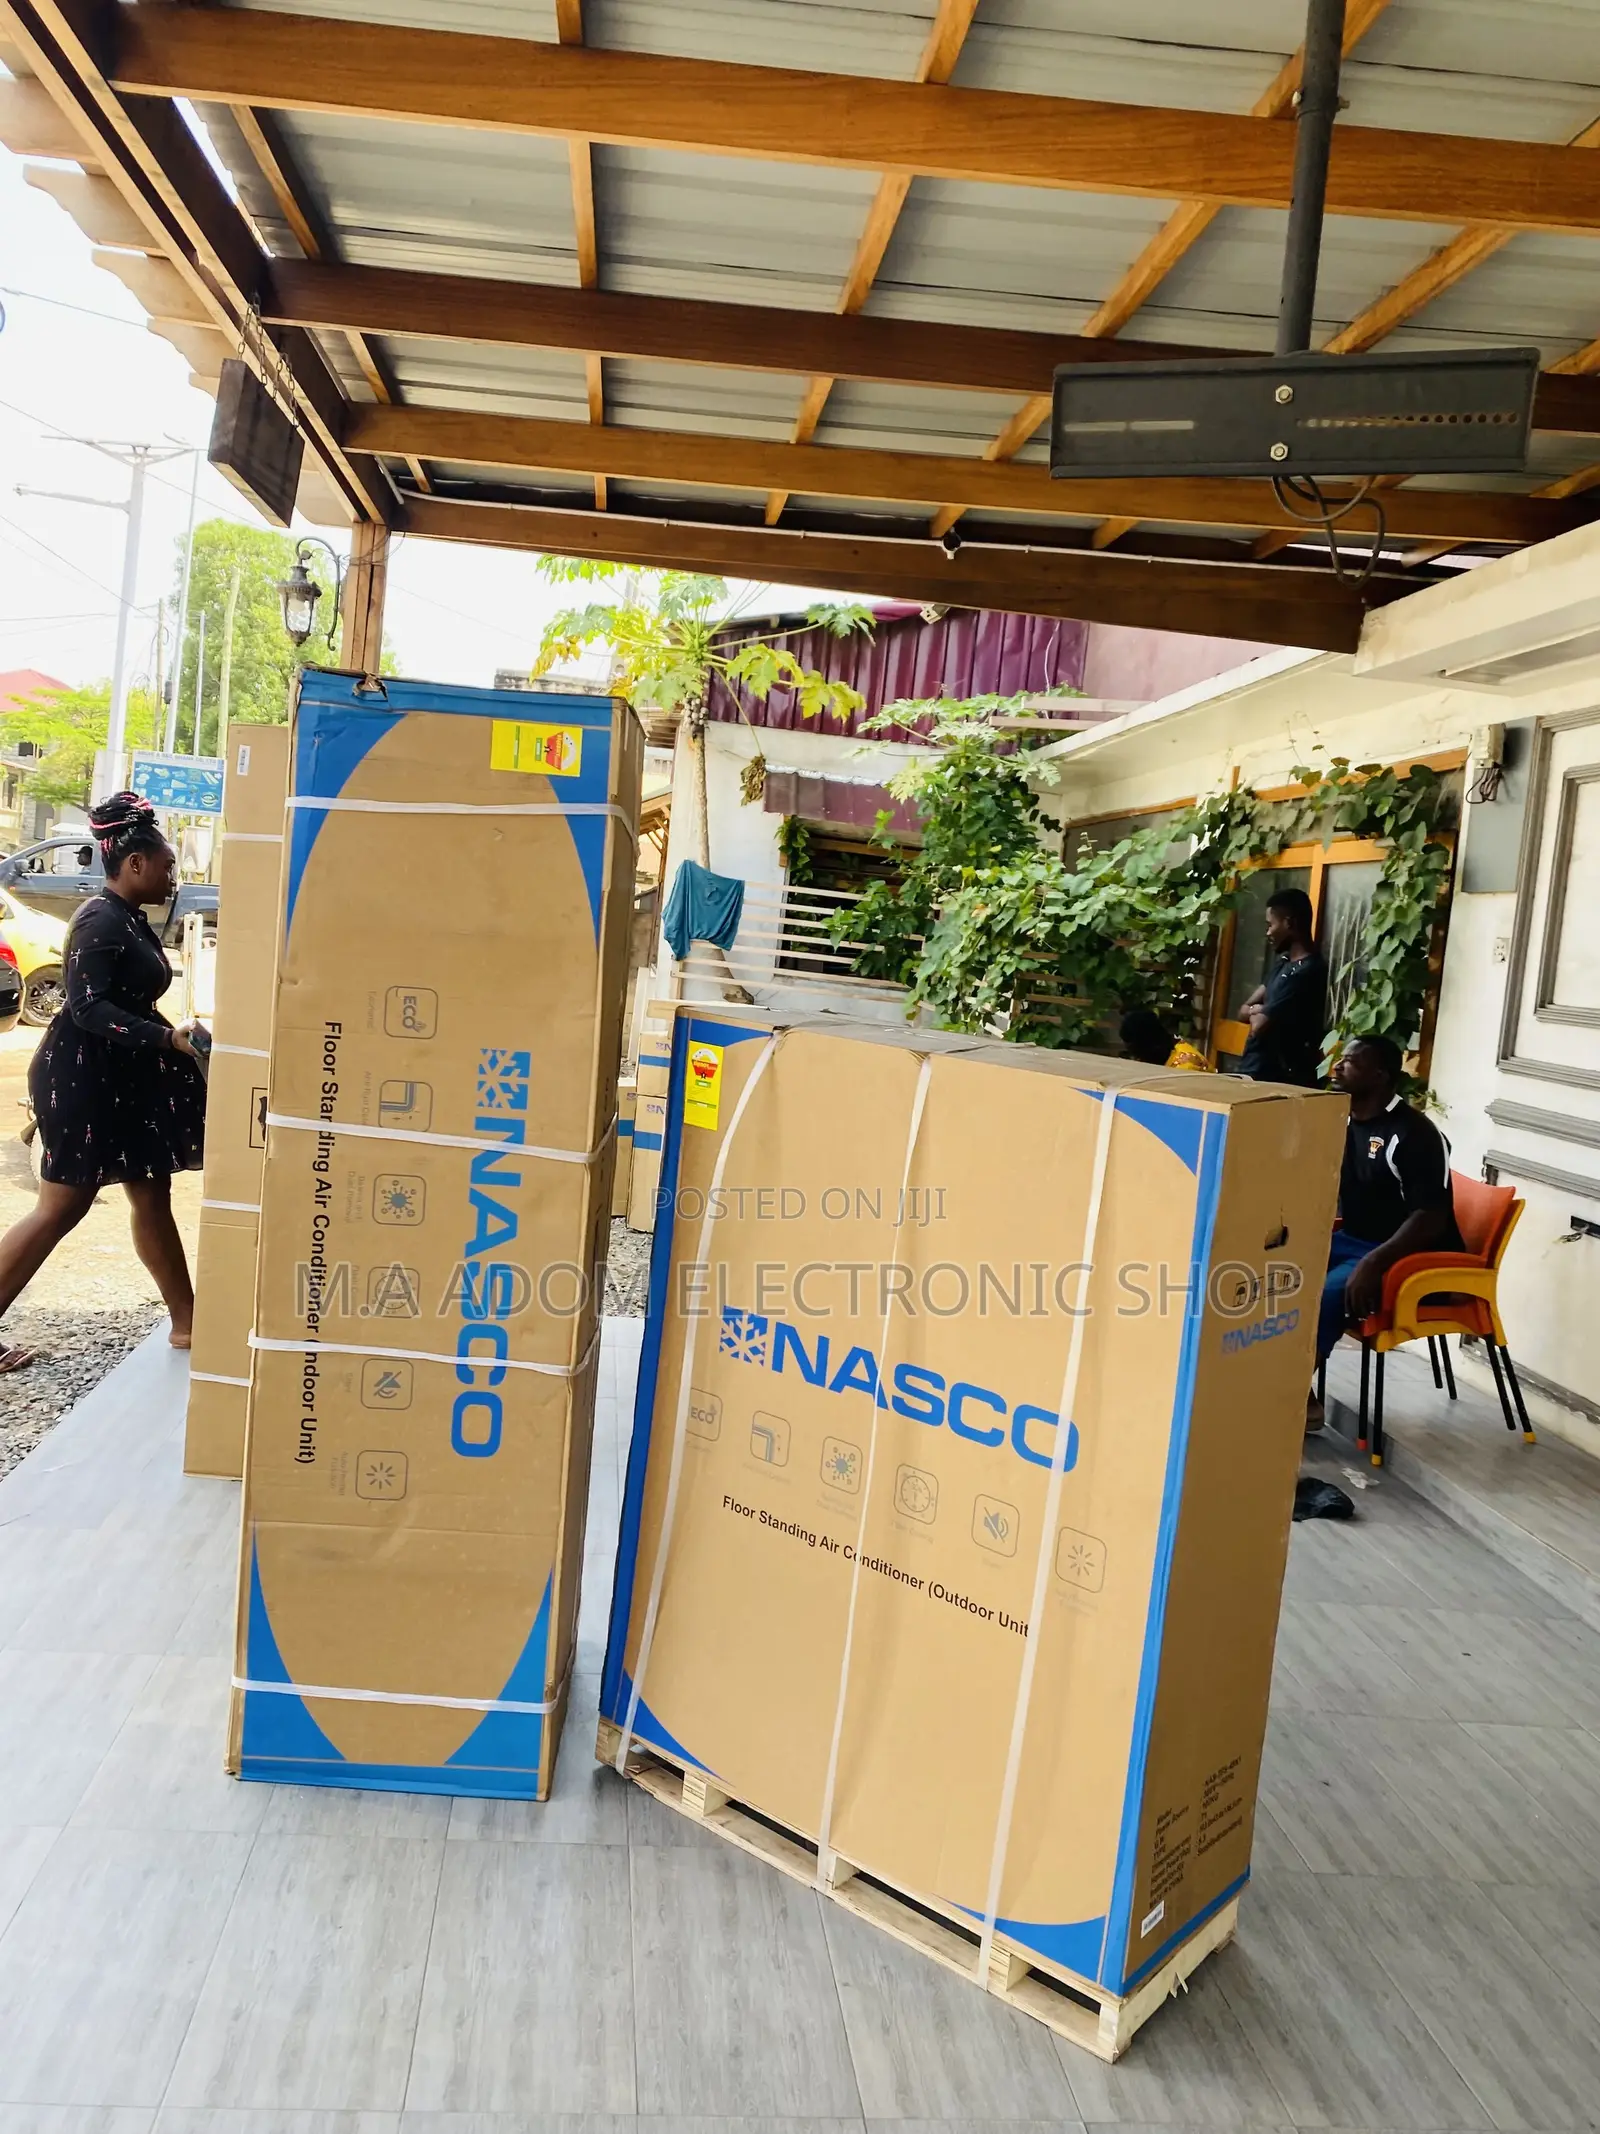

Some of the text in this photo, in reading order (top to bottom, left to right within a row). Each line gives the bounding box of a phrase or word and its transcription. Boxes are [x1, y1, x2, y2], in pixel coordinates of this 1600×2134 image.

[403, 995, 417, 1028] ECO
[321, 1021, 342, 1076] Floor
[313, 1177, 333, 1209] Air
[306, 1214, 331, 1334] Conditioner
[451, 1116, 526, 1458] NASCO
[1237, 1309, 1301, 1349] NASCO
[690, 1406, 715, 1425] ECO
[771, 1321, 1080, 1473] NASCO
[294, 1417, 318, 1464] Unit)
[722, 1495, 756, 1519] Floor
[759, 1510, 817, 1547] Standing
[819, 1536, 840, 1554] Air
[843, 1545, 924, 1591] Conditioner
[928, 1581, 995, 1621] (Outdoor
[999, 1611, 1031, 1638] Unit
